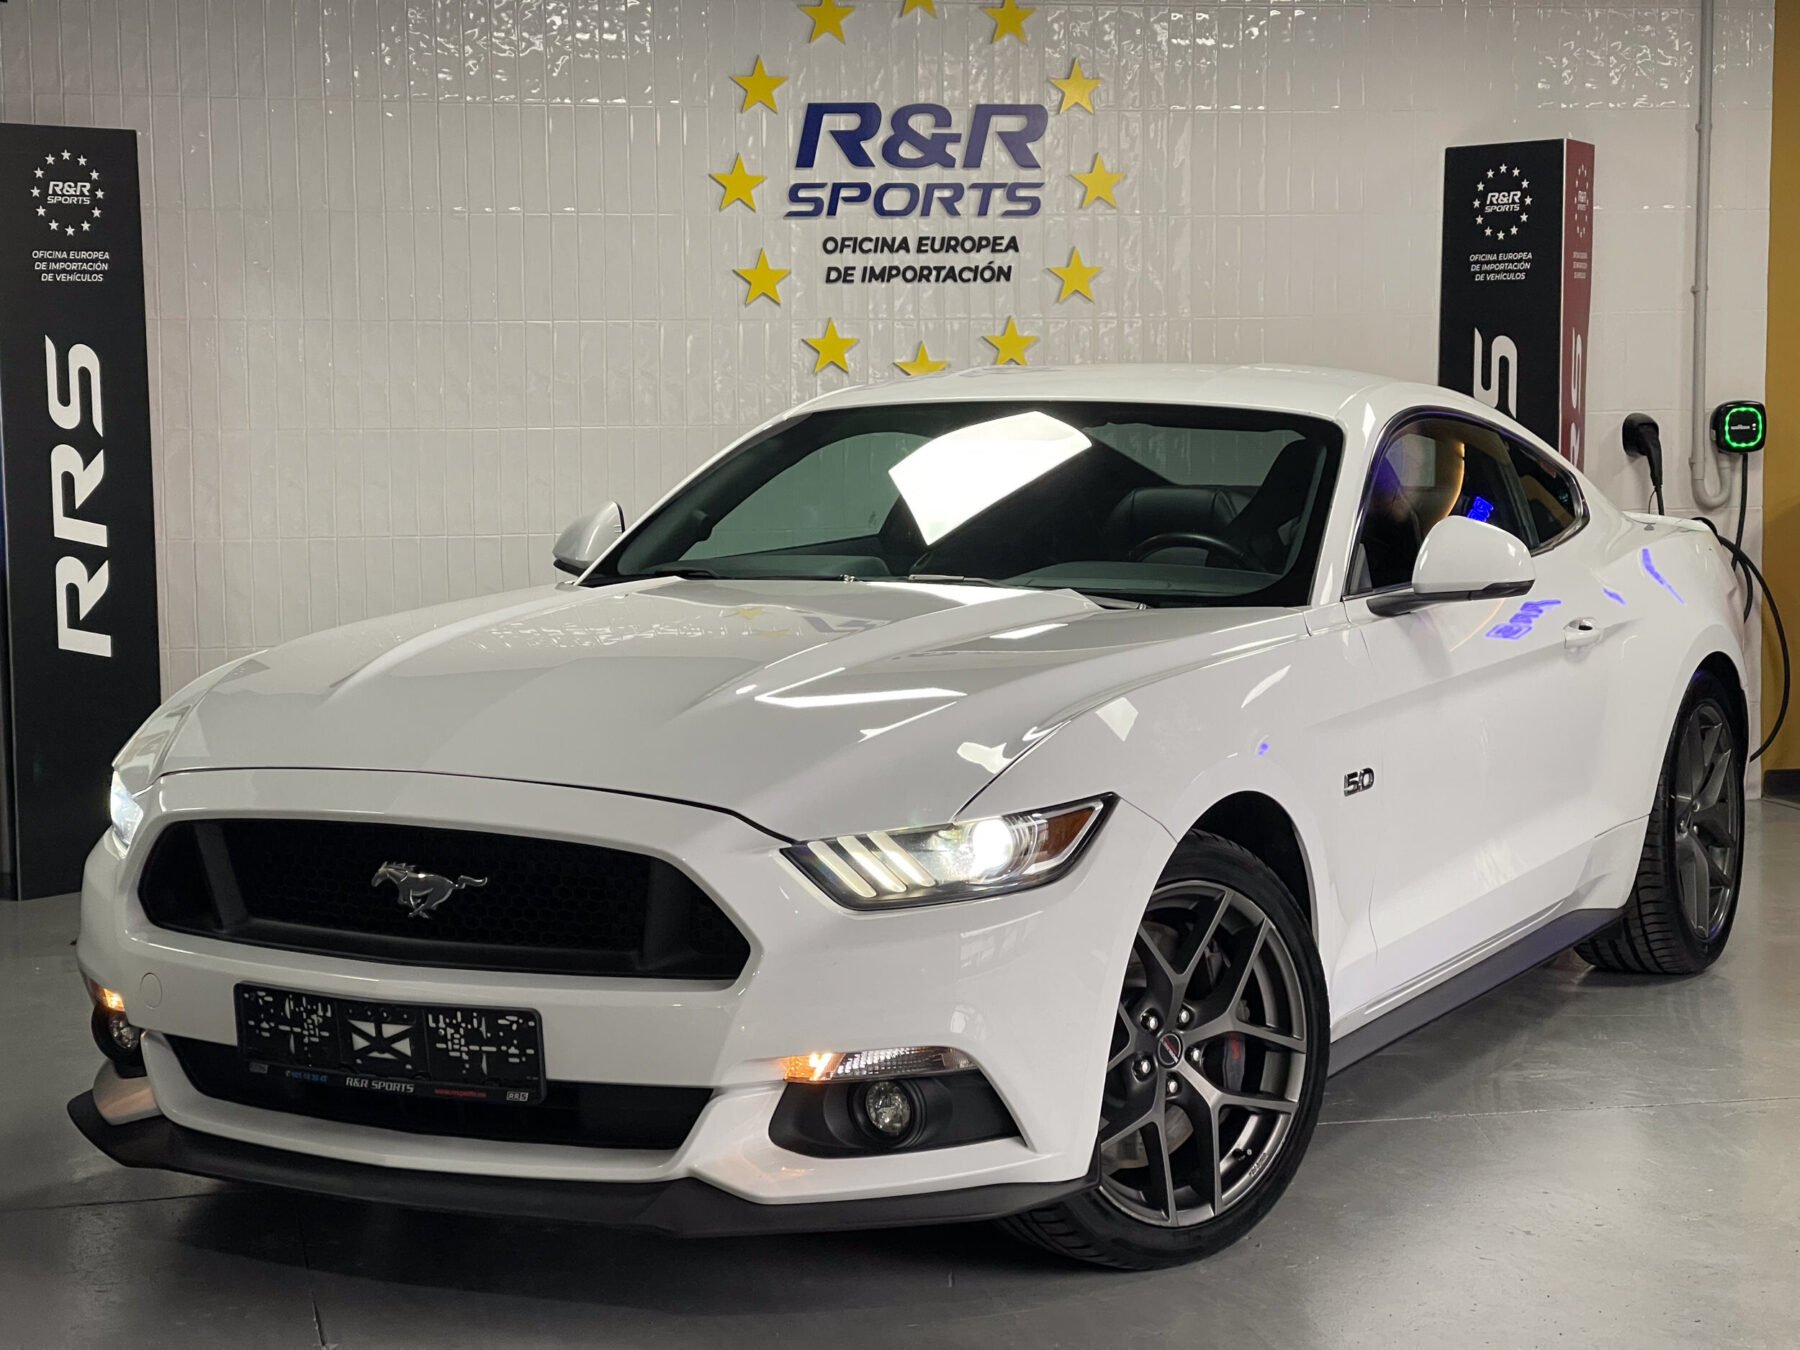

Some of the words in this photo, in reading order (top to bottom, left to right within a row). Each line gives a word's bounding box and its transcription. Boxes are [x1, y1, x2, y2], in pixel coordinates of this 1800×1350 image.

[795, 102, 1049, 169] R&R
[48, 181, 91, 195] R&R
[47, 196, 91, 204] SPORTS
[783, 181, 1047, 218] SPORTS
[1486, 191, 1522, 205] R&R
[1484, 204, 1520, 213] SPORTS
[822, 236, 911, 255] OFICINA
[916, 235, 1020, 254] EUROPEA
[32, 250, 68, 260] OFICINA
[69, 251, 110, 260] EUROPEA
[1469, 253, 1497, 261] OFICINA
[1498, 252, 1533, 261] EUROPEA
[34, 261, 47, 271] DE
[48, 261, 109, 271] IMPORTACIÓN
[825, 265, 856, 284] DE
[861, 260, 1012, 284] IMPORTACIÓN
[1470, 264, 1481, 272] DE
[1481, 261, 1532, 271] IMPORTACIÓN
[41, 273, 54, 282] DE
[55, 272, 104, 282] VEHÍCULOS
[1474, 273, 1486, 281] DE
[1486, 272, 1527, 281] VEHÍCULOS
[45, 334, 112, 658] RRS
[345, 1076, 369, 1089] R&R
[371, 1080, 415, 1094] SPORTS
